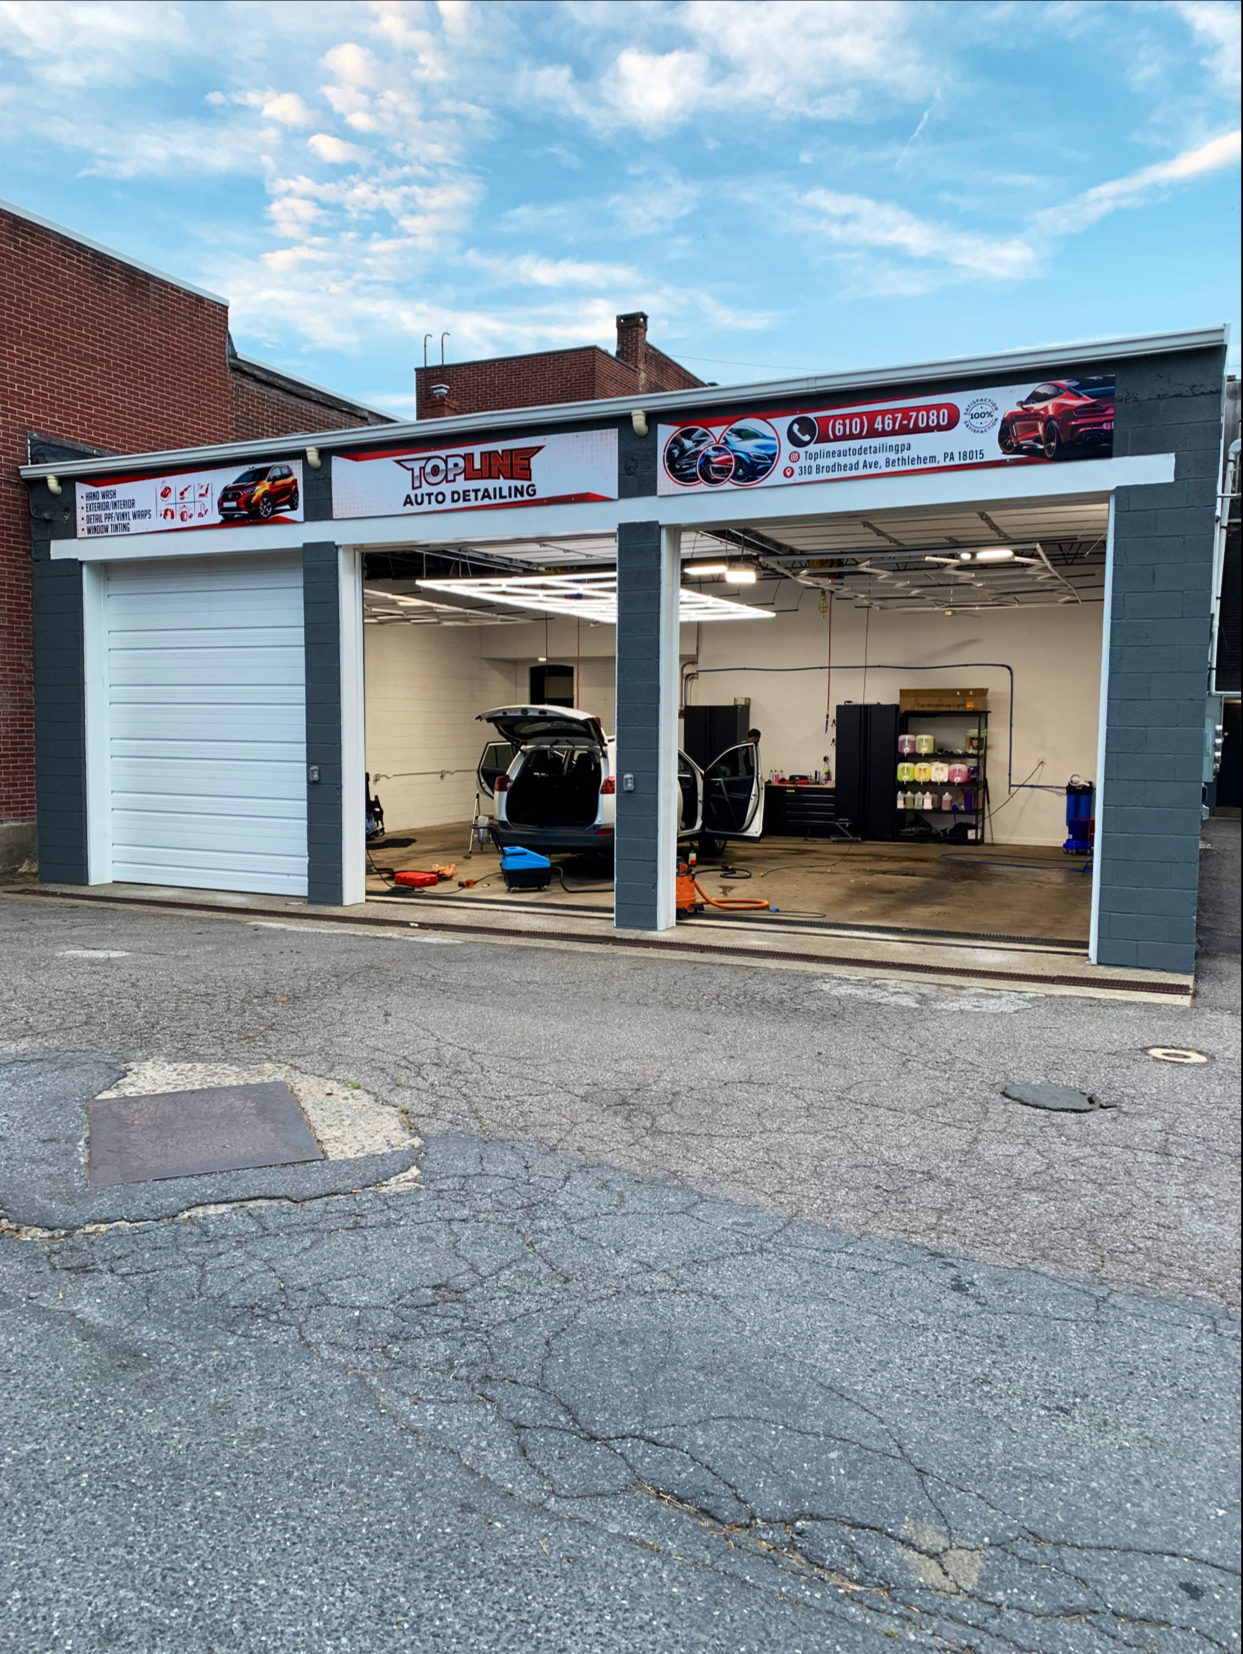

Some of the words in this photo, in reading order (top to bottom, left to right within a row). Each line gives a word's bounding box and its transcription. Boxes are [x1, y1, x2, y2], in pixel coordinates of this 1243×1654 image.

[963, 398, 999, 416] SATISFACTION
[970, 411, 994, 420] 100%
[828, 416, 868, 439] (610)
[874, 408, 948, 432] 467-7080
[963, 417, 999, 434] SATISFACTION
[804, 442, 912, 462] Toplineautodetailingpa
[392, 445, 547, 490] TOPLINE
[798, 465, 813, 477] 310
[815, 460, 860, 475] Brodhead
[862, 458, 882, 471] Ave,
[885, 453, 941, 469] Bethlehem,
[943, 452, 955, 463] PA
[958, 449, 985, 462] 18015
[85, 491, 100, 501] HAND
[101, 489, 117, 500] WASH
[402, 490, 446, 508] AUTO
[451, 483, 537, 504] DETAILING
[85, 499, 135, 512] EXTERIOR/INTERIOR
[86, 513, 104, 525] DETAIL
[104, 511, 131, 523] PPF/VINYL
[132, 509, 152, 520] WRAPS
[87, 524, 109, 535] WINDOW
[110, 522, 130, 533] TINTING
